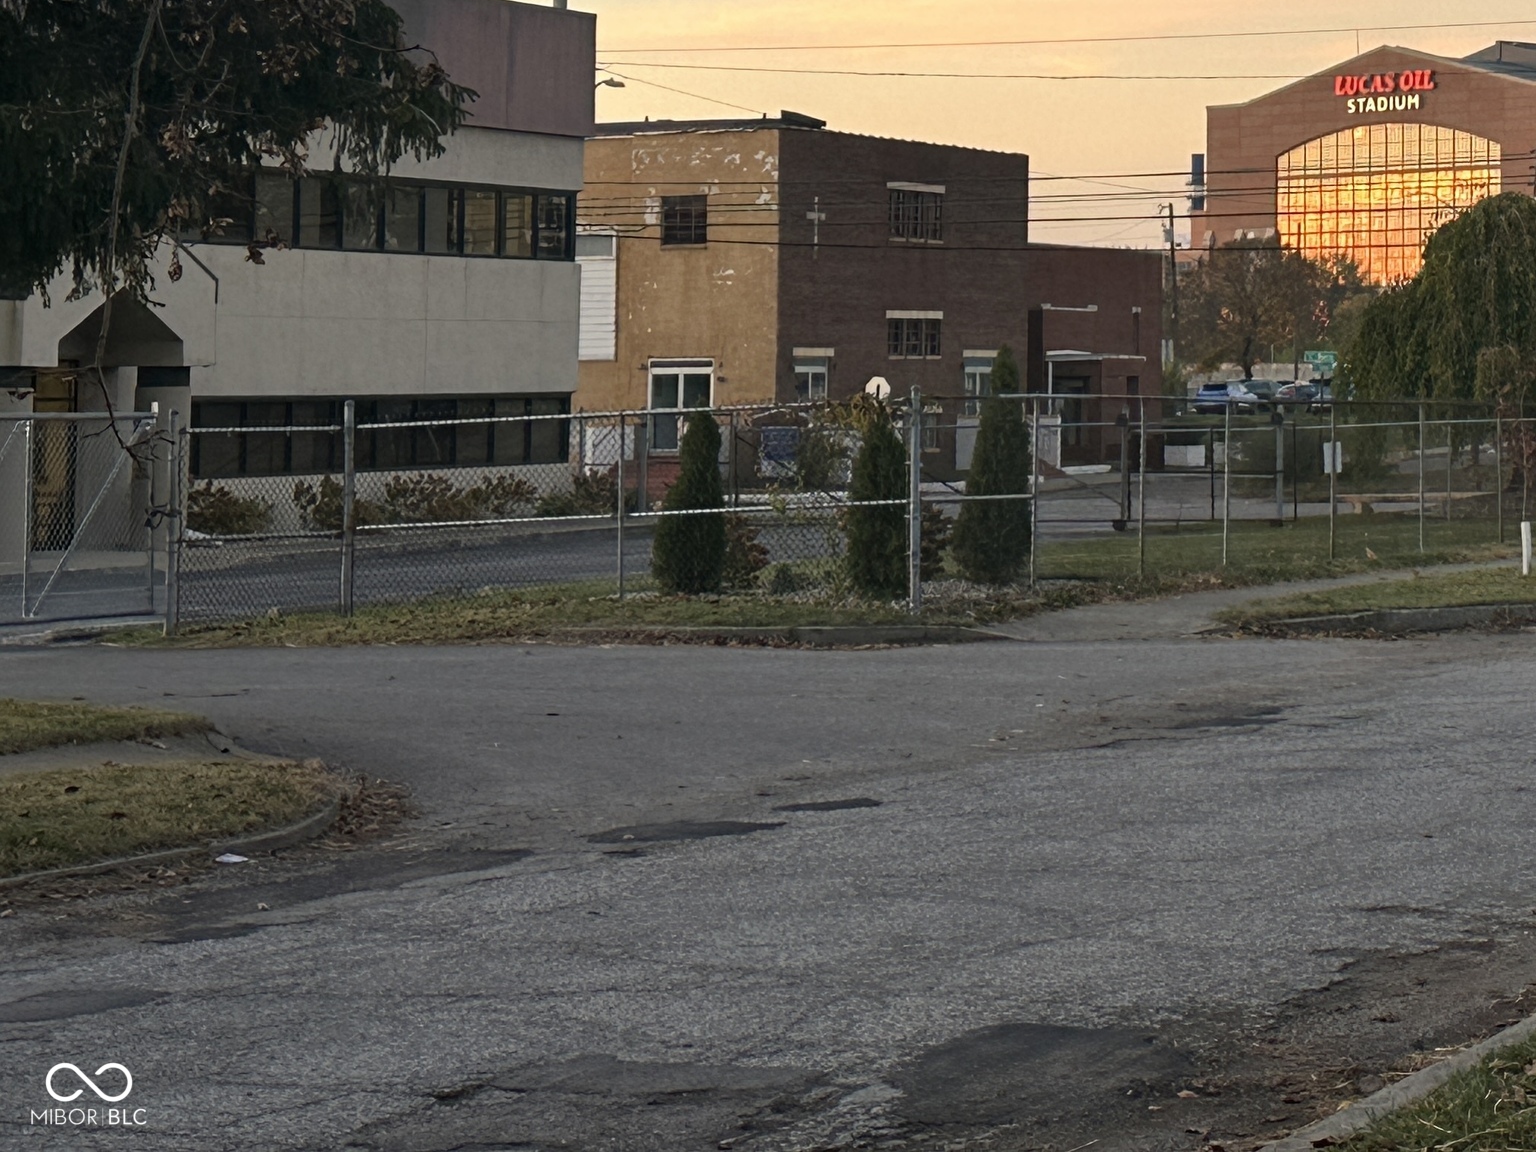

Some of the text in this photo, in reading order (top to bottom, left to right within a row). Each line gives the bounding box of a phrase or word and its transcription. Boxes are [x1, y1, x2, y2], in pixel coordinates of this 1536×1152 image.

[1334, 69, 1434, 96] LUCAS OIL
[1347, 94, 1420, 114] STADIUM
